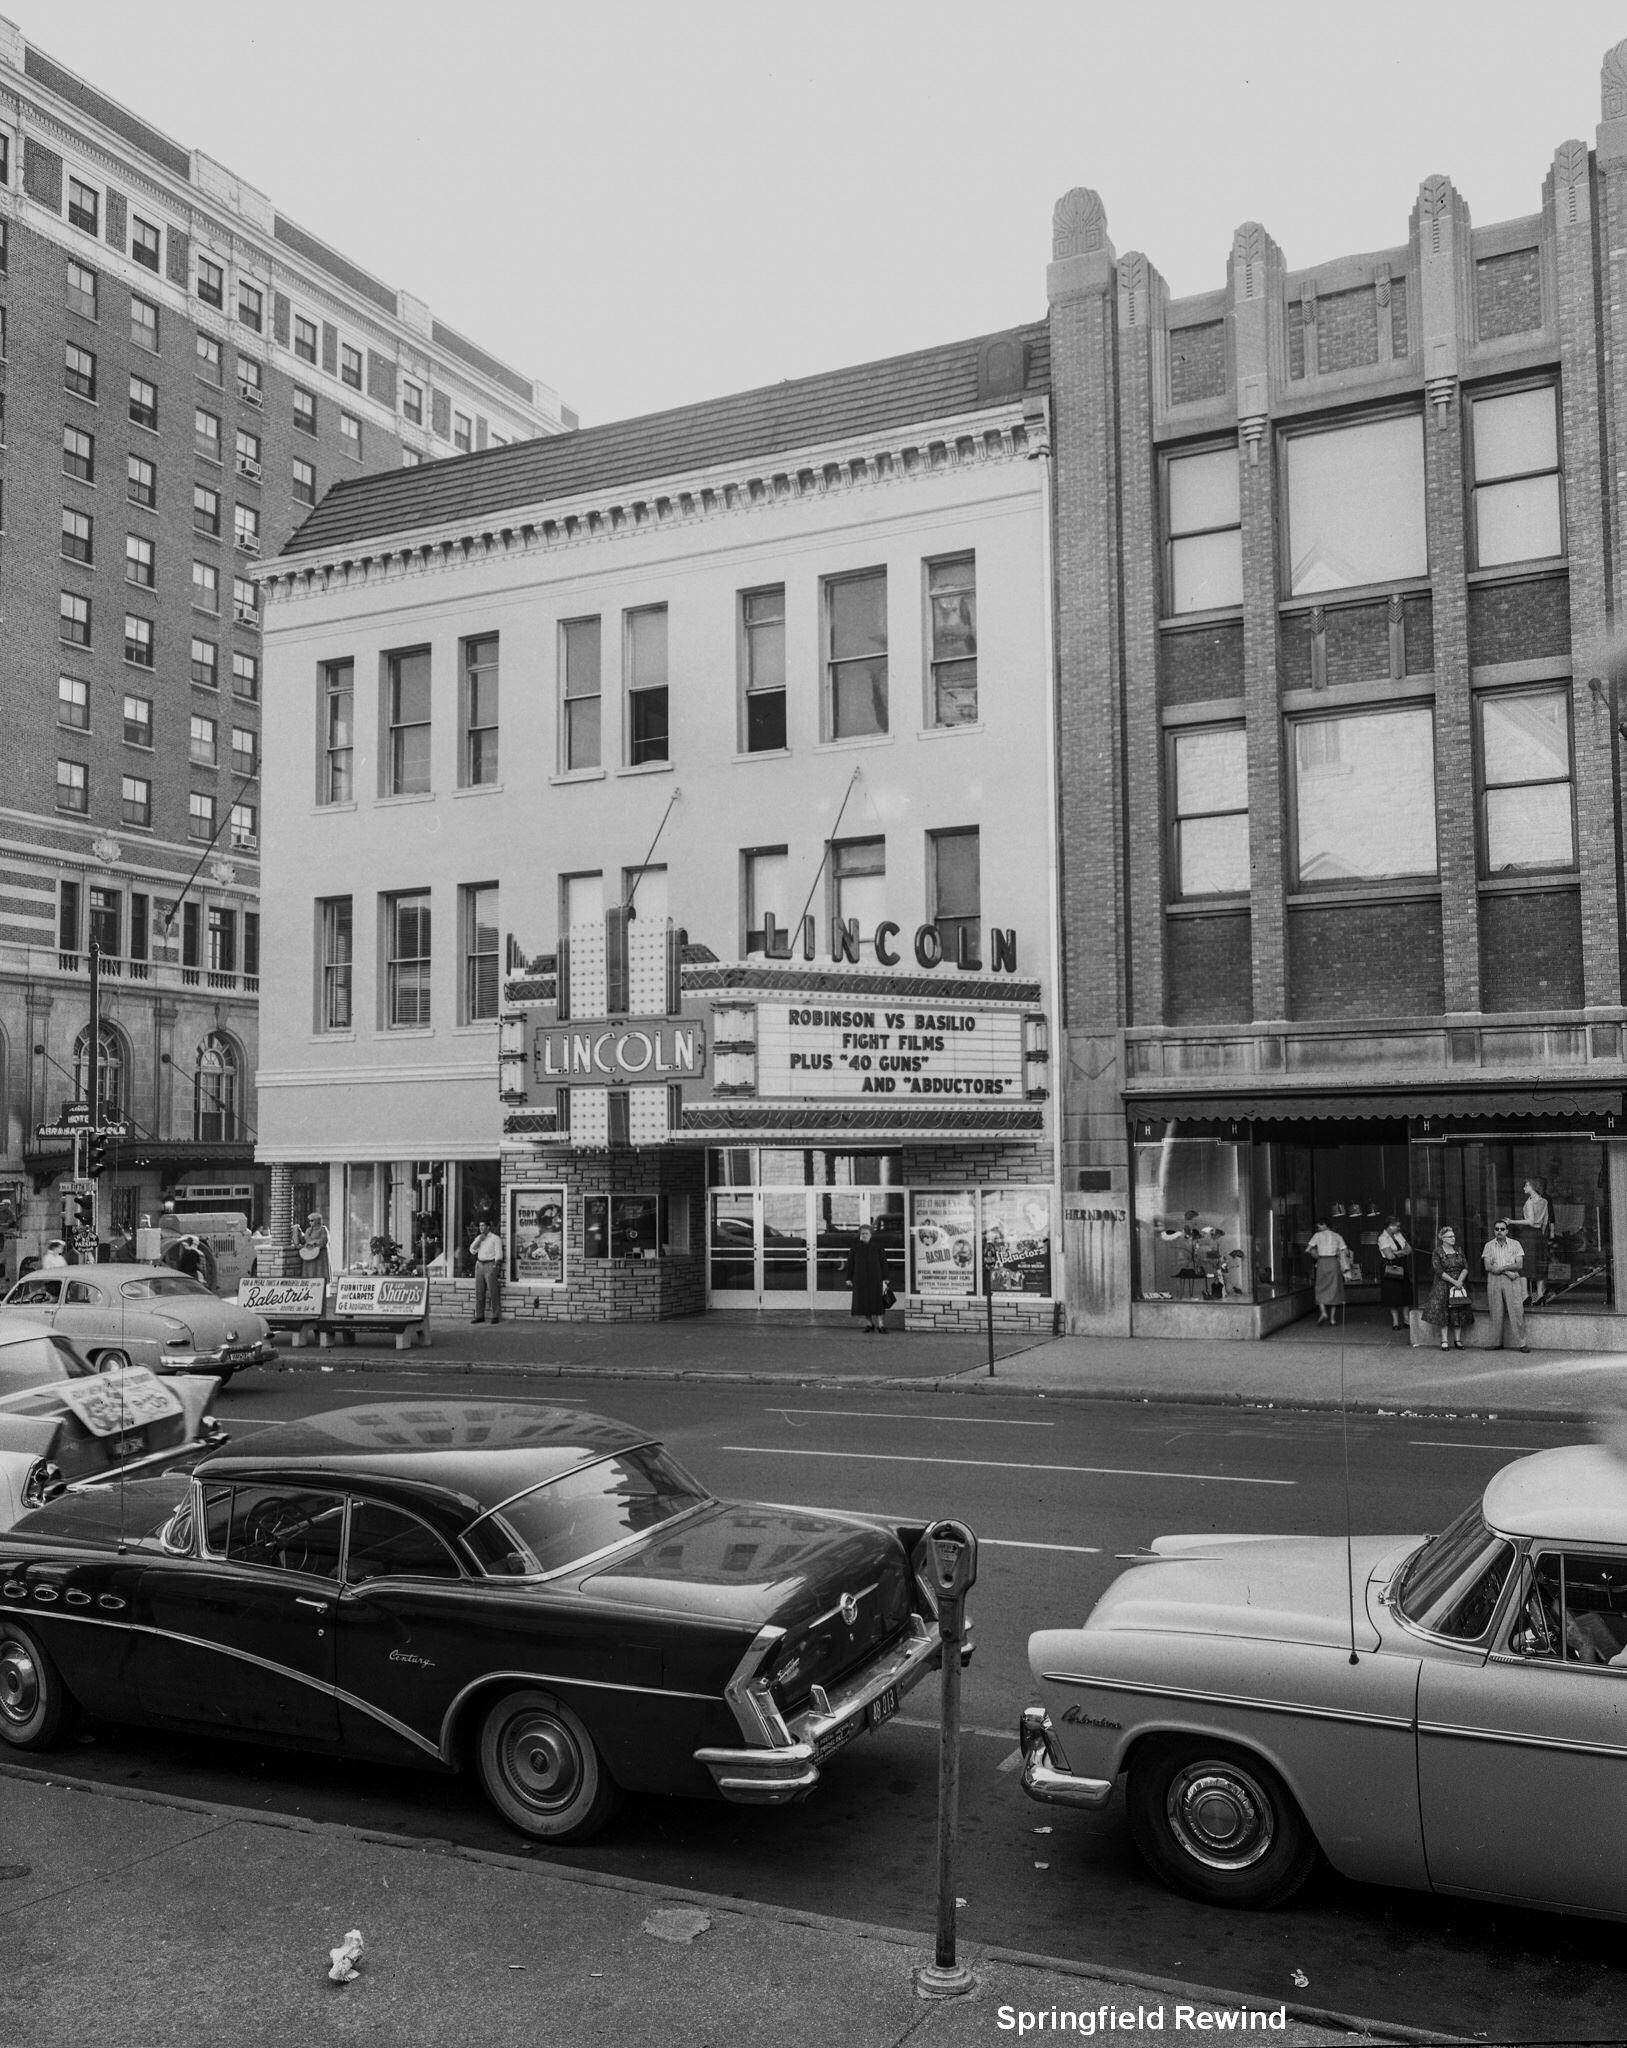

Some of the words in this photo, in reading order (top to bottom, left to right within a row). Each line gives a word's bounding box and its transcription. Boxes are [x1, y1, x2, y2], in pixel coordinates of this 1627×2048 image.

[764, 912, 1017, 973] LINCOLN
[788, 1009, 875, 1028] ROBINSON
[885, 1013, 905, 1029] VS
[915, 1014, 976, 1031] BASILIO
[842, 1033, 890, 1050] FIGHT
[899, 1035, 945, 1051] FILMS
[544, 1029, 694, 1075] LINCOLN
[790, 1053, 833, 1070] PLUS
[879, 1055, 929, 1072] GUNS"
[862, 1077, 896, 1092] AND
[903, 1077, 1013, 1095] "ABDUCTORS"
[1144, 1125, 1151, 1136] H
[1232, 1123, 1239, 1135] H
[1423, 1120, 1430, 1132] H
[1608, 1117, 1614, 1129] H
[243, 1286, 314, 1308] Balestri's
[348, 1292, 375, 1300] CARPETS
[379, 1282, 423, 1304] Sharp's
[389, 1649, 435, 1669] Century
